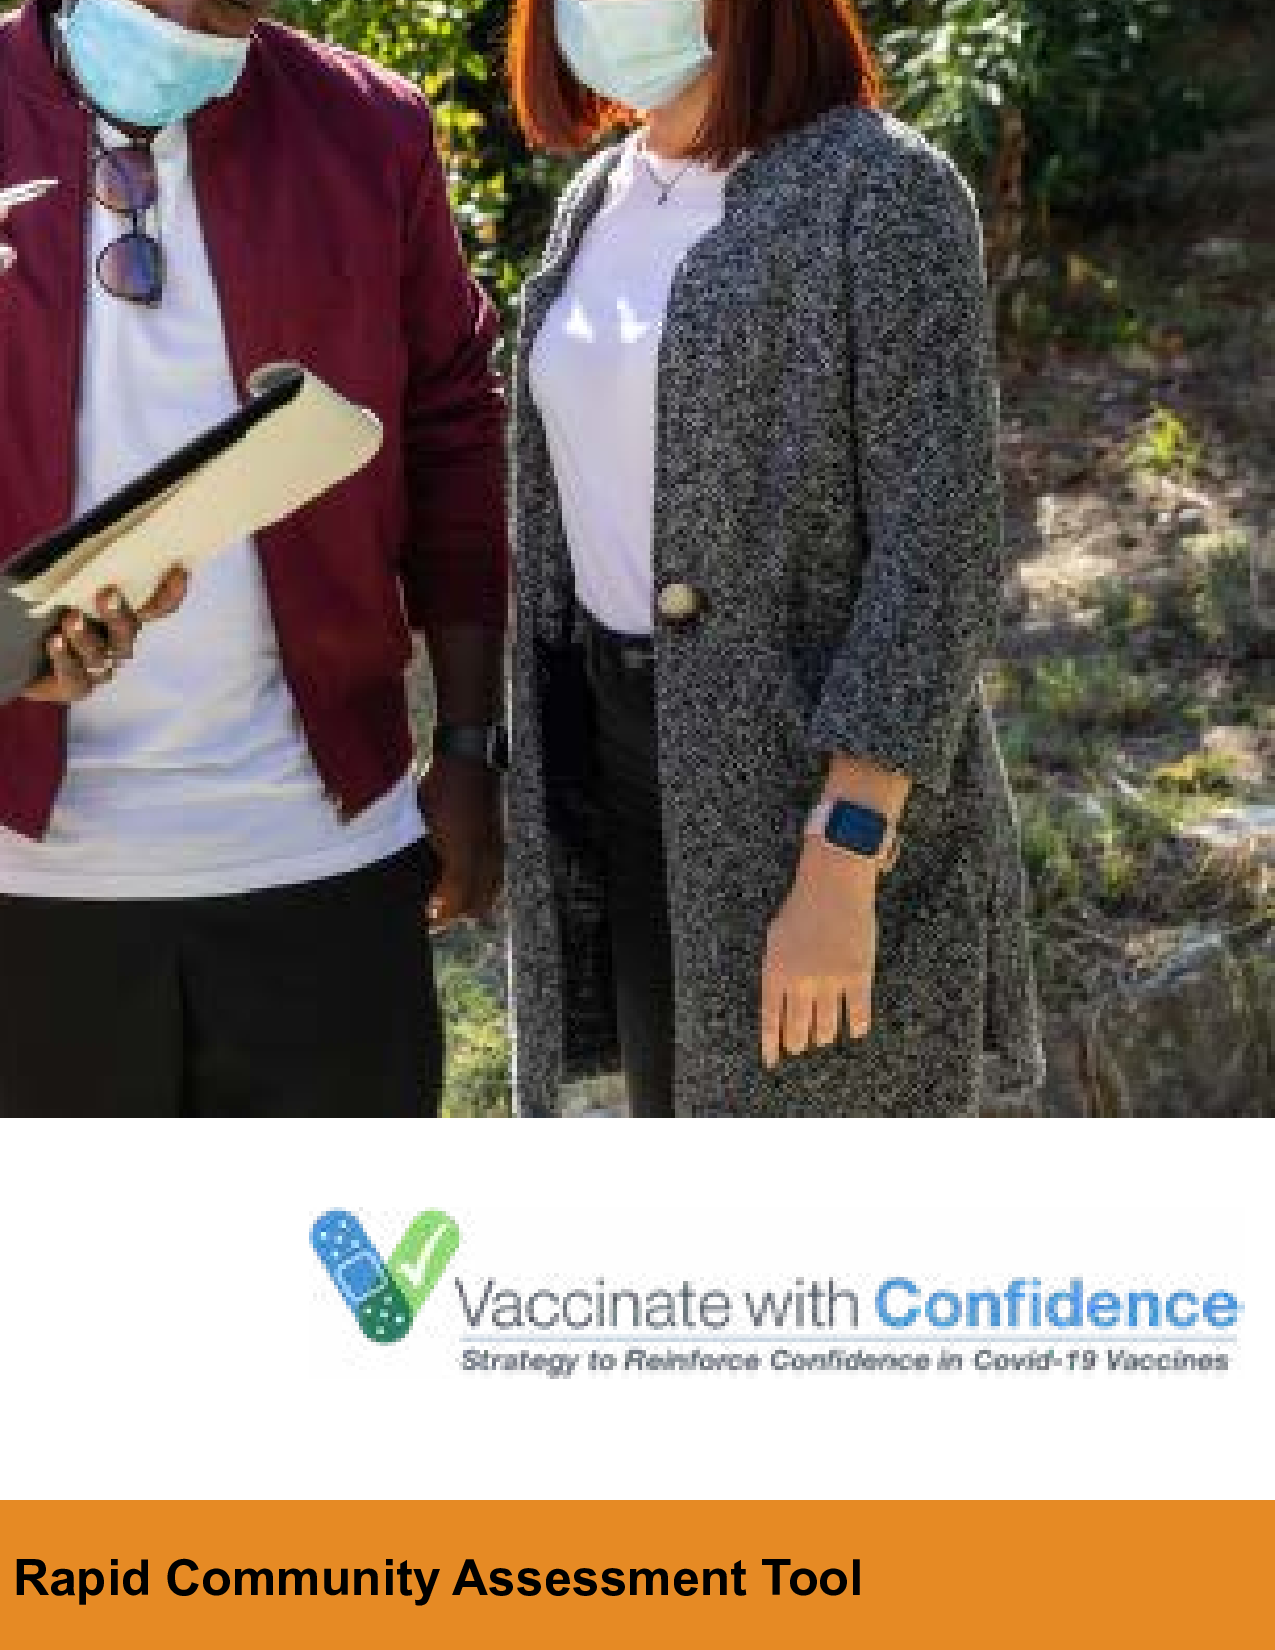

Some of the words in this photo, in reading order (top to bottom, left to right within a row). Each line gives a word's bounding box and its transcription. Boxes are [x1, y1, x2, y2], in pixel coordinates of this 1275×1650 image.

[456, 1277, 732, 1330] Vaccinate
[744, 1277, 860, 1329] with
[875, 1276, 1242, 1330] Confidence
[460, 1349, 582, 1378] Strategy
[16, 1558, 149, 1606] Rapid
[167, 1558, 440, 1606] Community
[452, 1558, 747, 1597] Assessment
[762, 1558, 861, 1597] Tool
